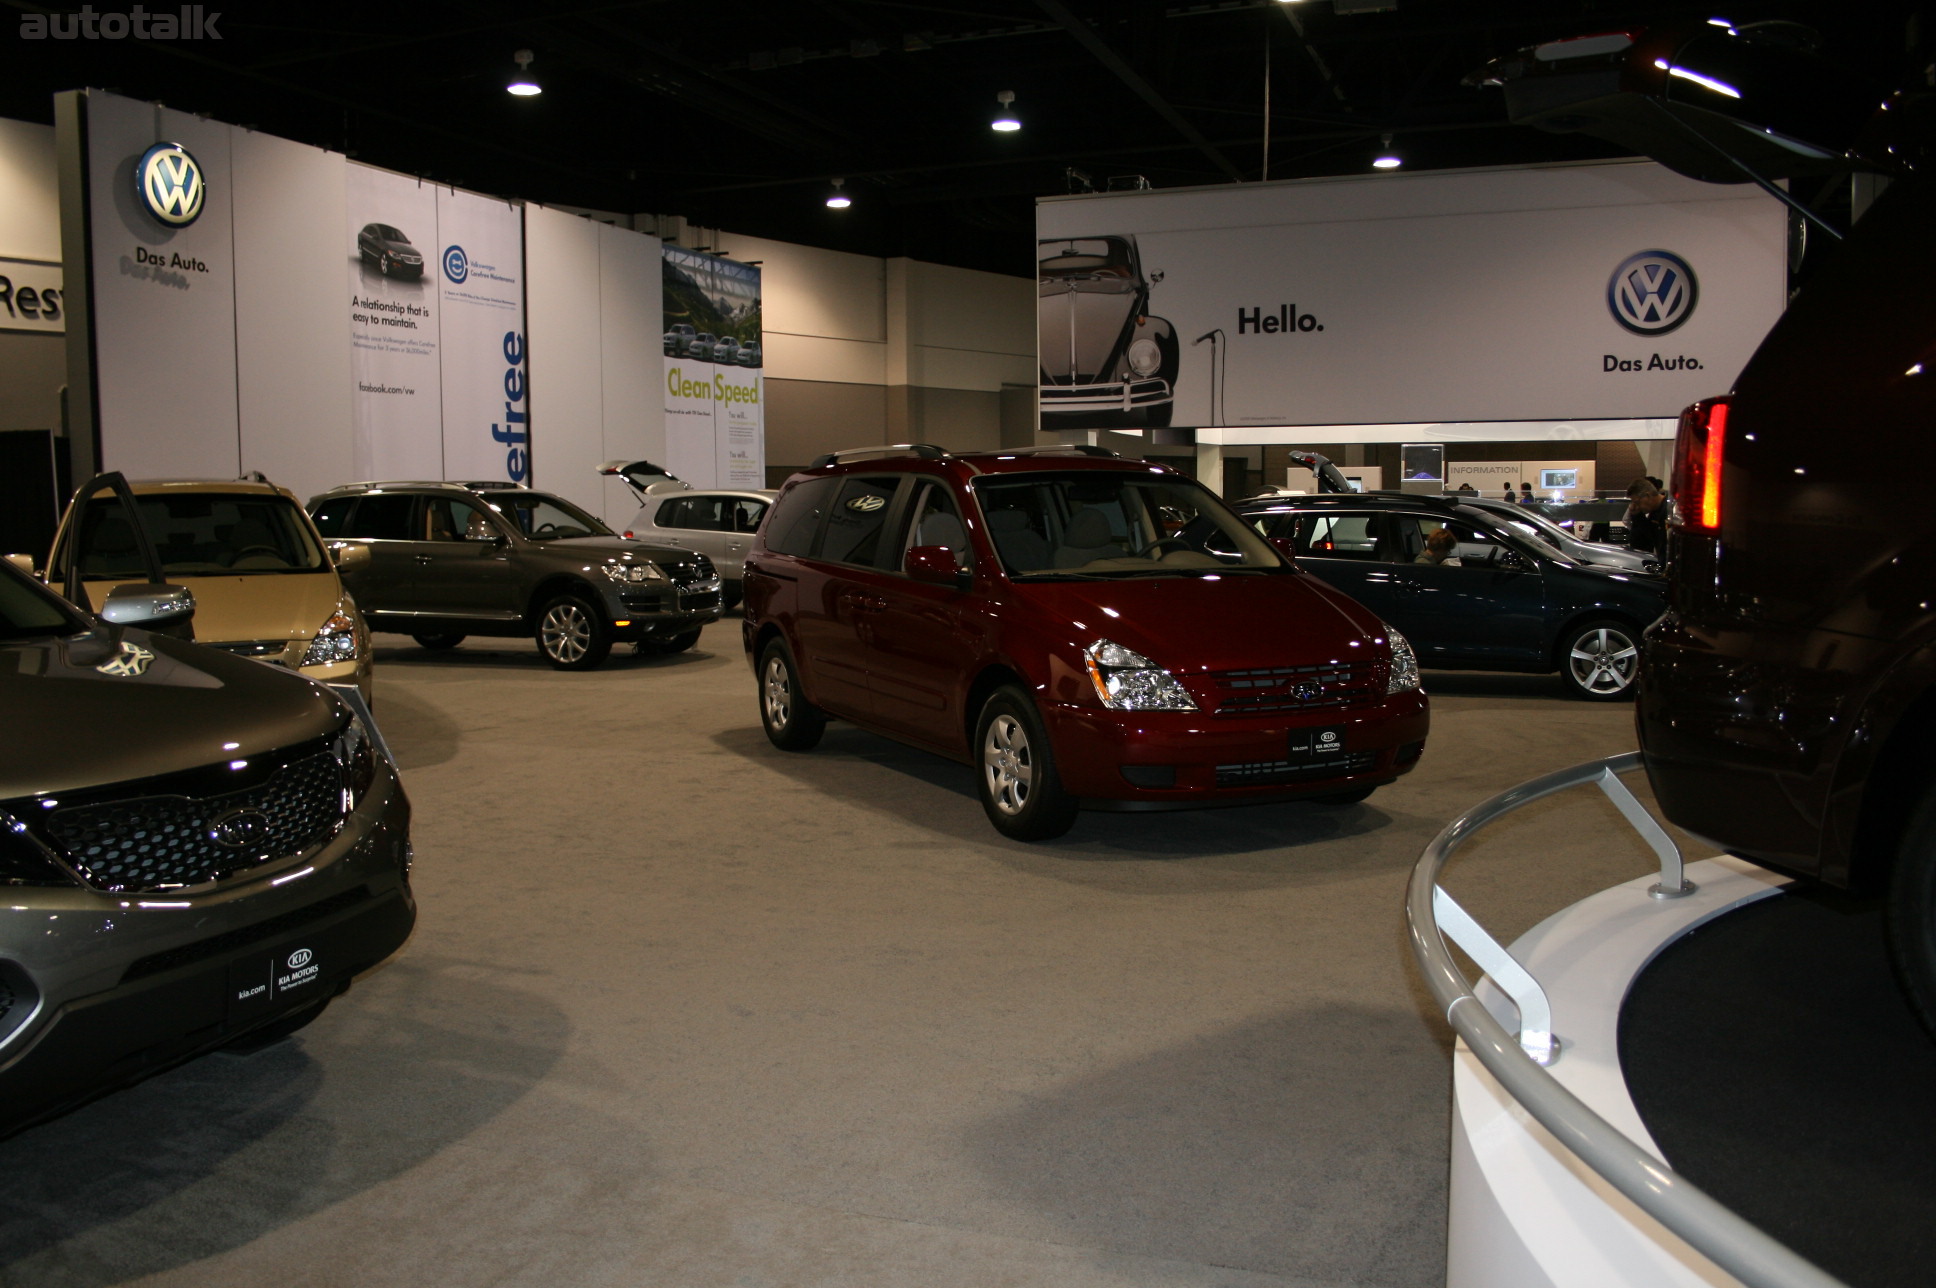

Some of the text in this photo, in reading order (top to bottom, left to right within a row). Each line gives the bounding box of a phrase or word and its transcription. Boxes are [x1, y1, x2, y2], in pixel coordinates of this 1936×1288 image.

[136, 246, 209, 274] Das Auto.
[0, 275, 64, 319] Res
[352, 295, 430, 318] A relationship that is
[353, 313, 418, 330] easy to maintain.
[1238, 304, 1324, 335] Hello.
[1603, 353, 1704, 373] Das Auto.
[667, 368, 758, 408] Clean Speed
[492, 331, 526, 482] efree
[1450, 466, 1519, 474] INFORMATION
[1322, 733, 1335, 741] KIA
[290, 950, 310, 967] KIA
[278, 964, 319, 986] KIA MOTORS
[238, 984, 266, 1000] kia.com
